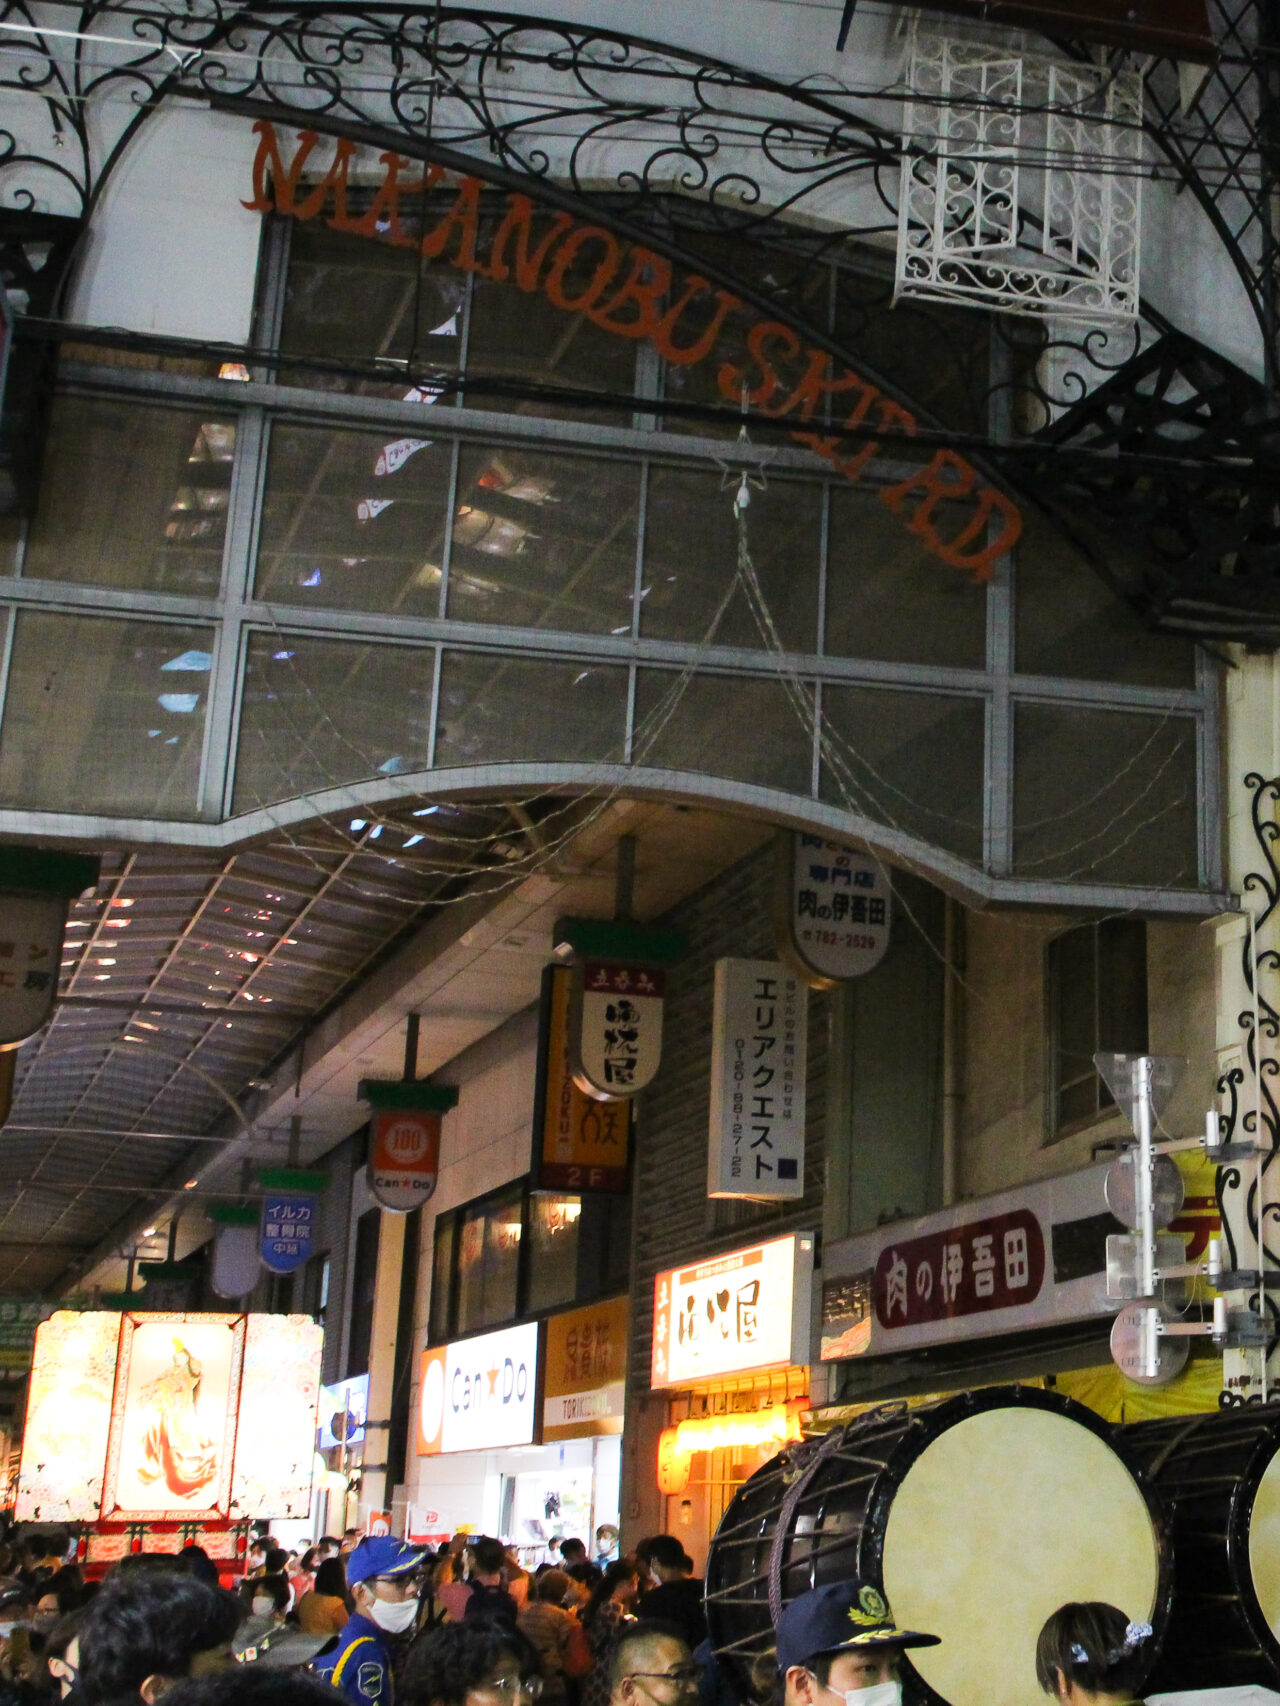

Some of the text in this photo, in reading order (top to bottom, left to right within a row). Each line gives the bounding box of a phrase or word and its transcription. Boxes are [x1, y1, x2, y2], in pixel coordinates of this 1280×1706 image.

[798, 889, 886, 926] 肉の伊吾田
[751, 978, 778, 1180] エリアクエスト
[568, 1166, 603, 1187] 2F
[268, 1204, 311, 1220] イルカ
[884, 1226, 1030, 1320] 肉の伊吾田
[451, 1357, 529, 1414] Can Do
